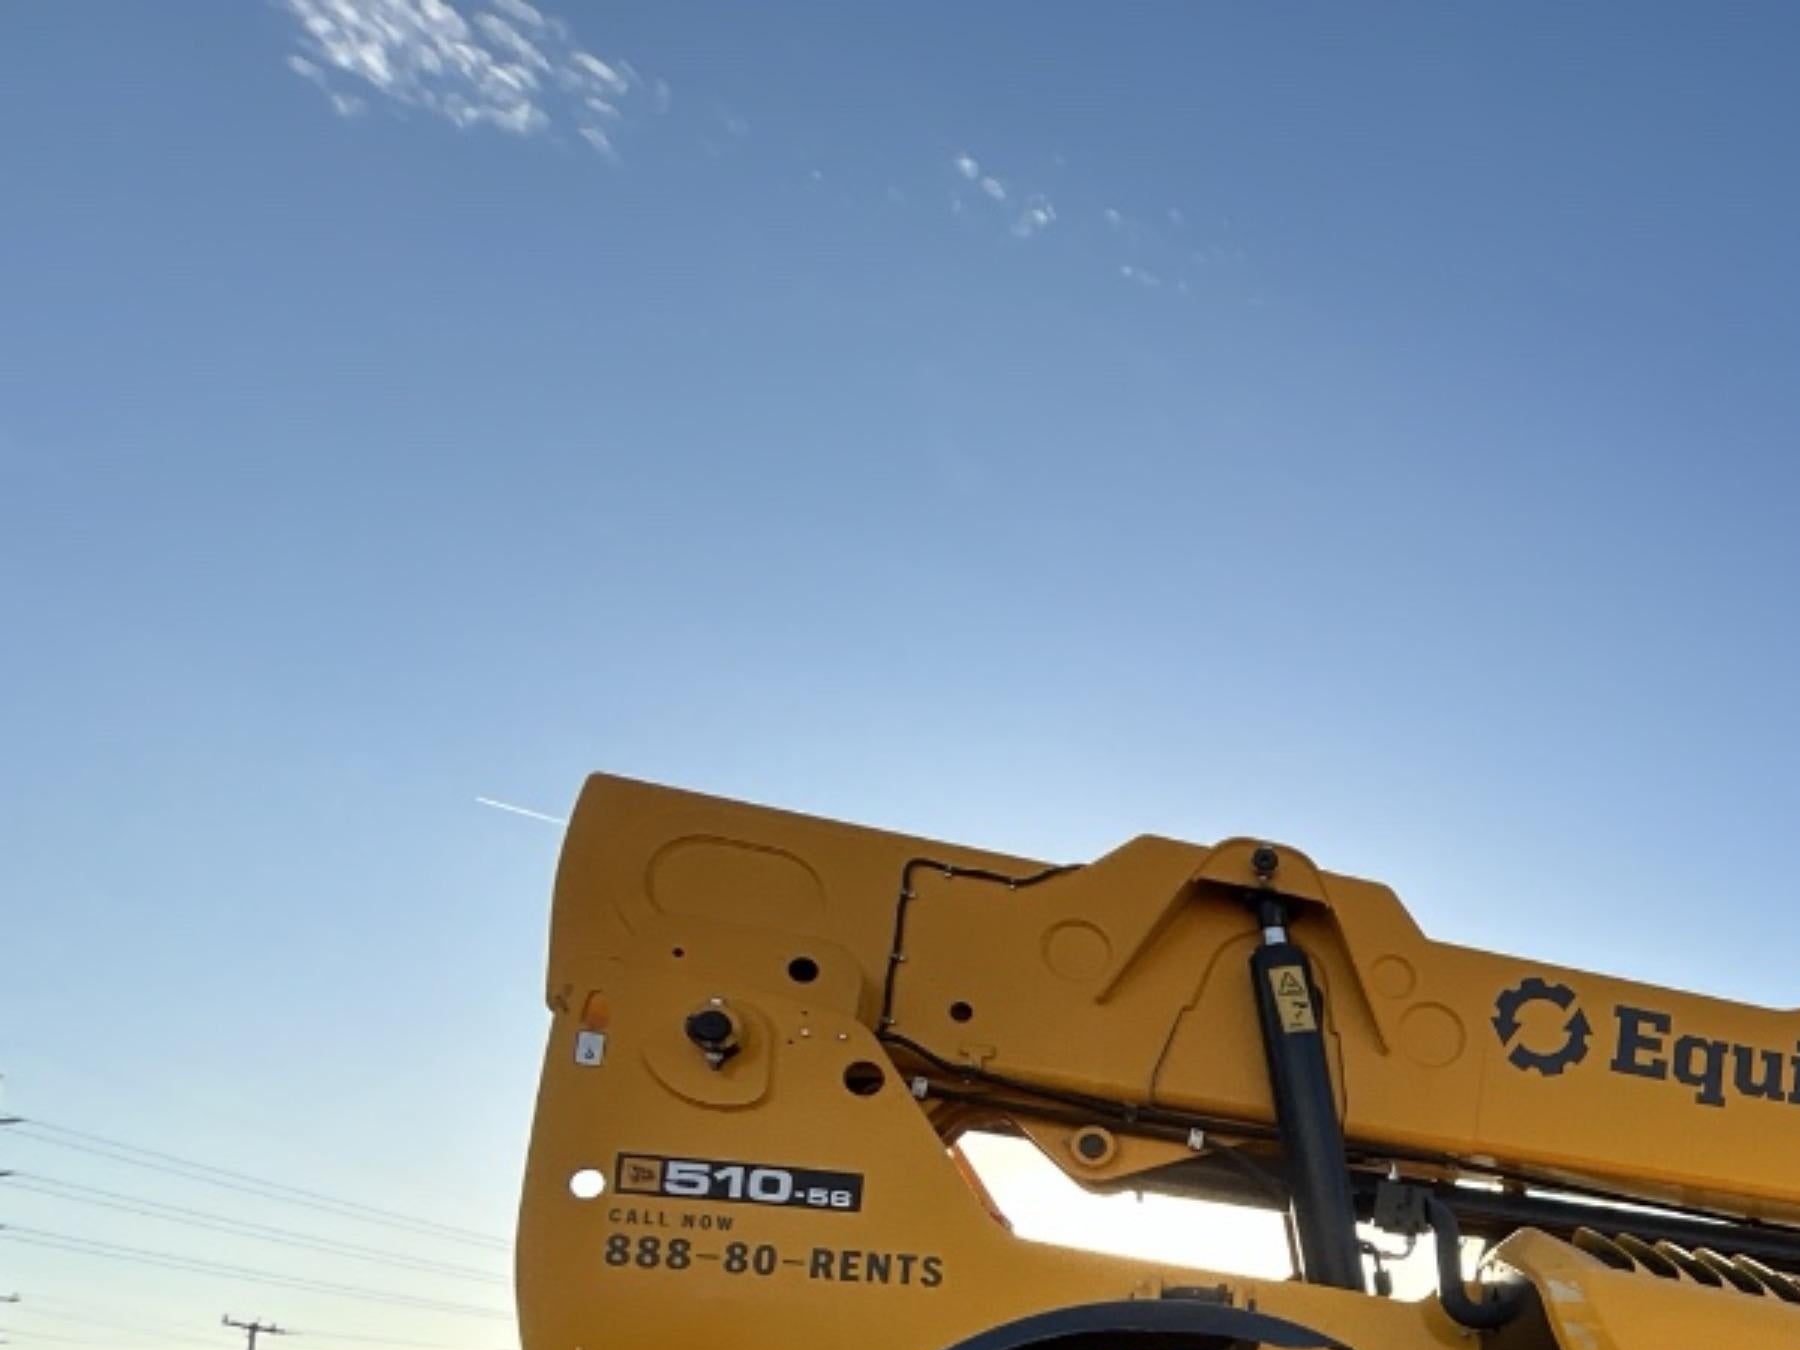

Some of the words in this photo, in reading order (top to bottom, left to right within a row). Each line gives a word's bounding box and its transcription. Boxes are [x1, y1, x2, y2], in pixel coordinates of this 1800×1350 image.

[608, 1208, 670, 1227] CALL
[681, 1213, 734, 1232] NOW
[605, 1233, 944, 1288] 888-80-RENTS
